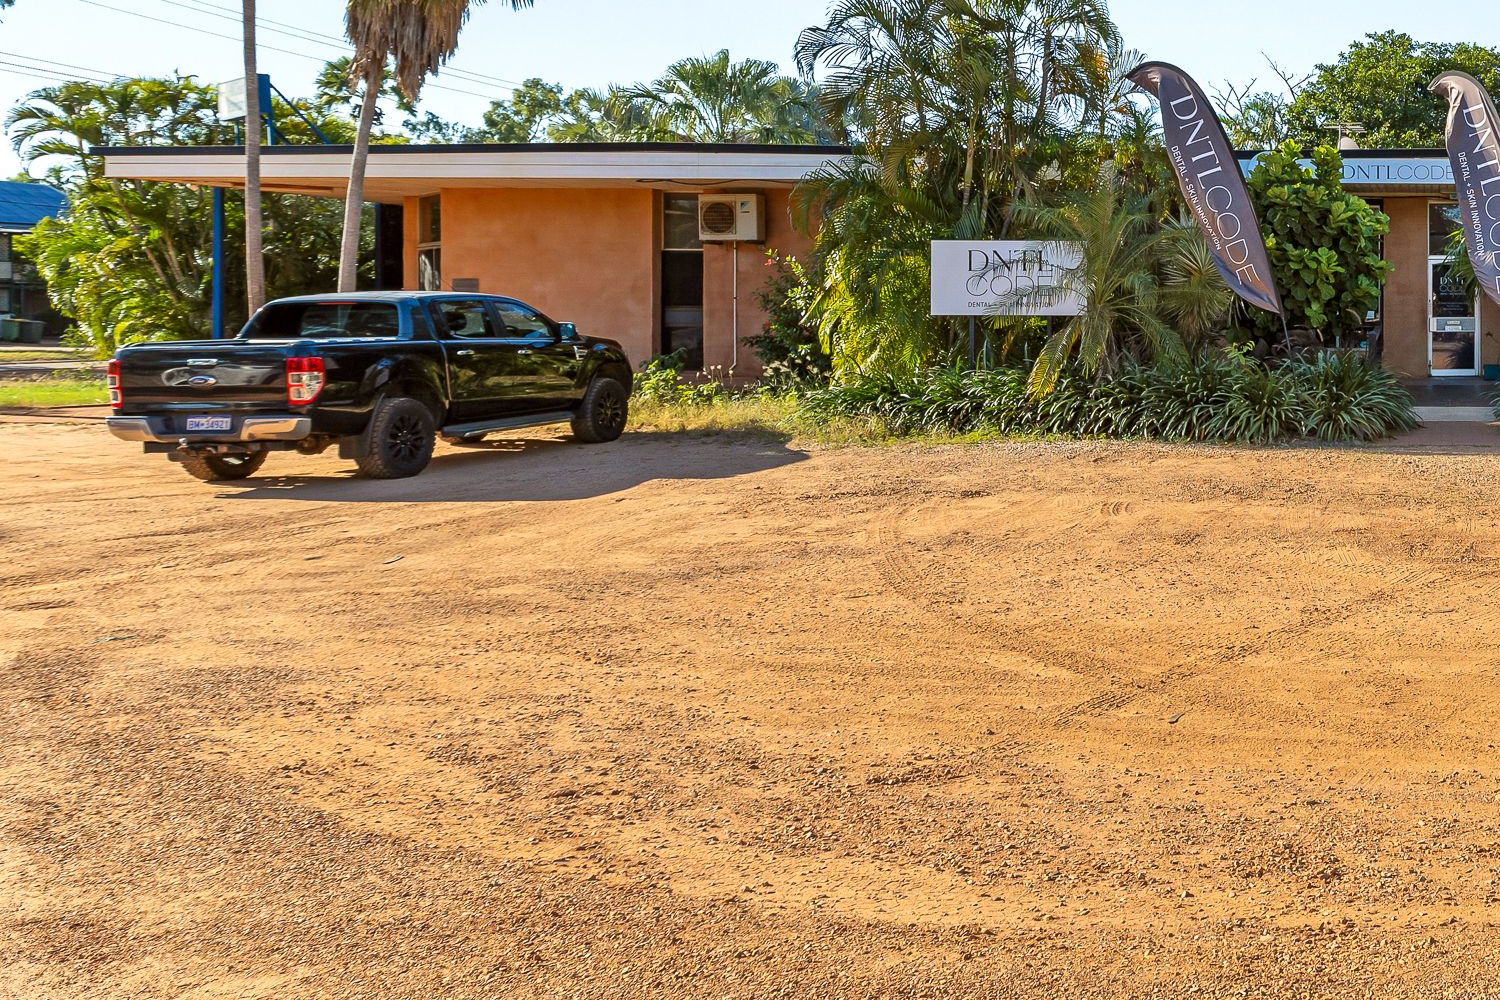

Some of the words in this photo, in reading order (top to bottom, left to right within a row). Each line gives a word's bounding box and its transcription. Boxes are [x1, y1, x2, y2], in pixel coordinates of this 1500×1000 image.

[1458, 151, 1469, 181] DENTAL
[1170, 94, 1260, 285] DNTLCODE
[1170, 145, 1186, 178] DENTAL
[1185, 183, 1199, 206] SKIN
[1195, 203, 1221, 251] INNOVATION
[1466, 189, 1478, 208] SKIN
[1471, 209, 1485, 257] INNOVATION
[968, 249, 1054, 272] DNTL
[966, 275, 1054, 296] CODE
